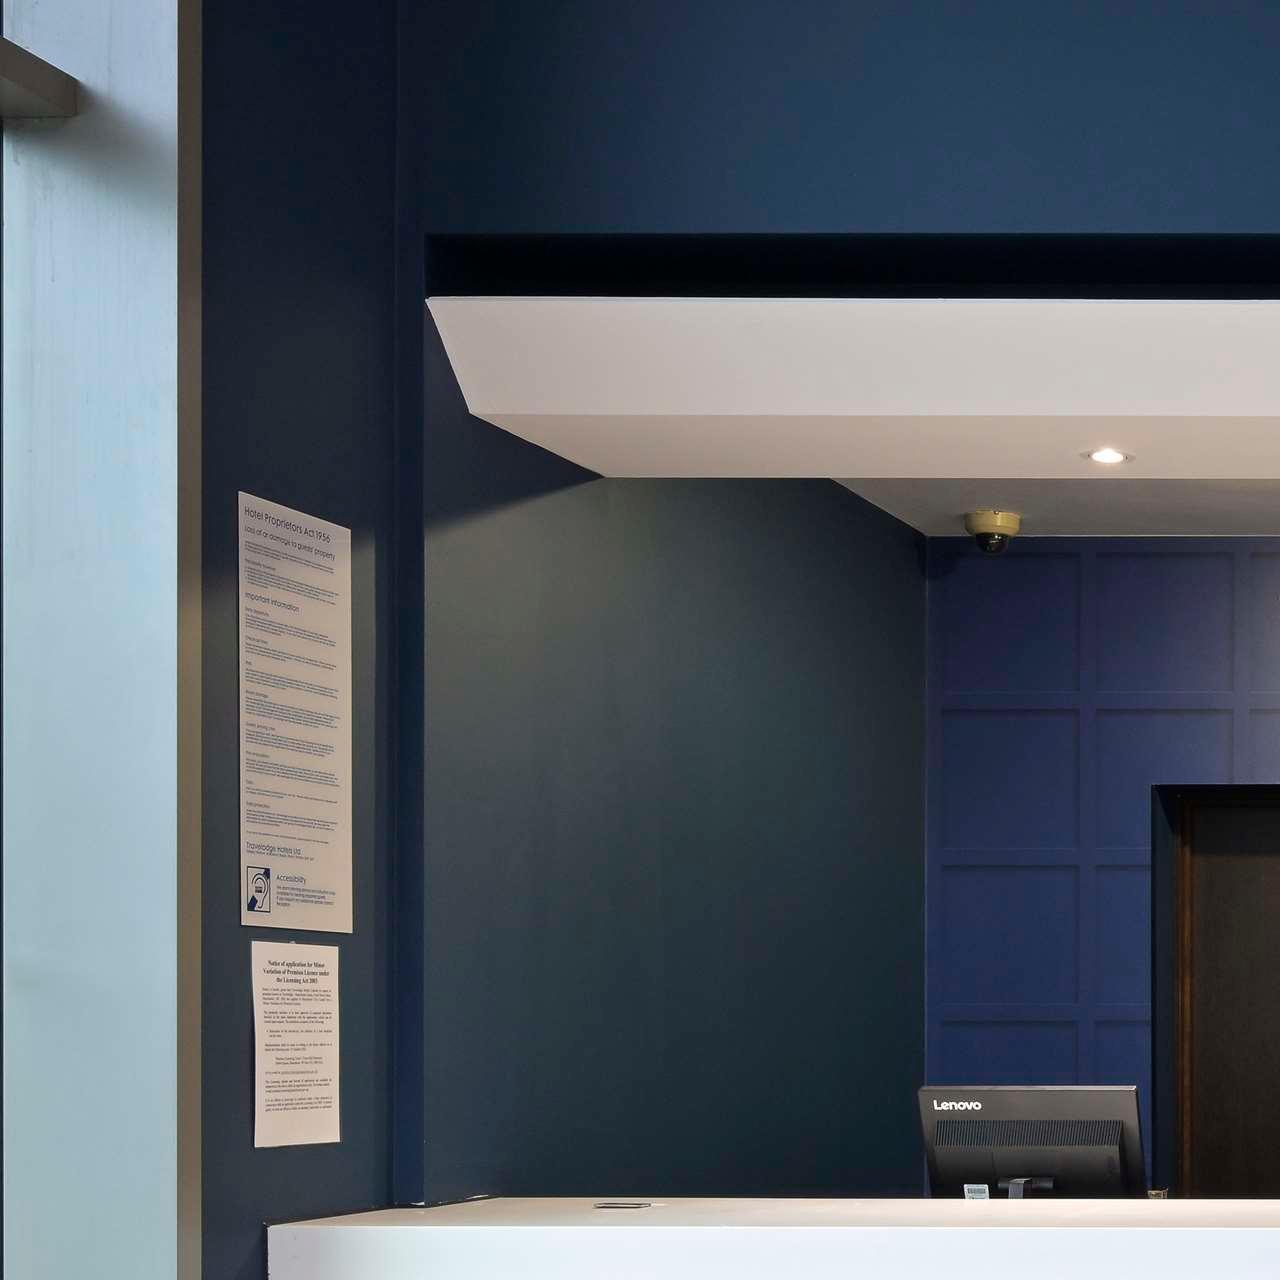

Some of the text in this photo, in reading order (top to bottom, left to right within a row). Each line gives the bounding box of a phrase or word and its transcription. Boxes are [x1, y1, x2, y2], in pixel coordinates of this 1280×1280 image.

[244, 506, 331, 544] Hotel Proprietors Act 1956
[933, 1099, 982, 1111] Lenovo
